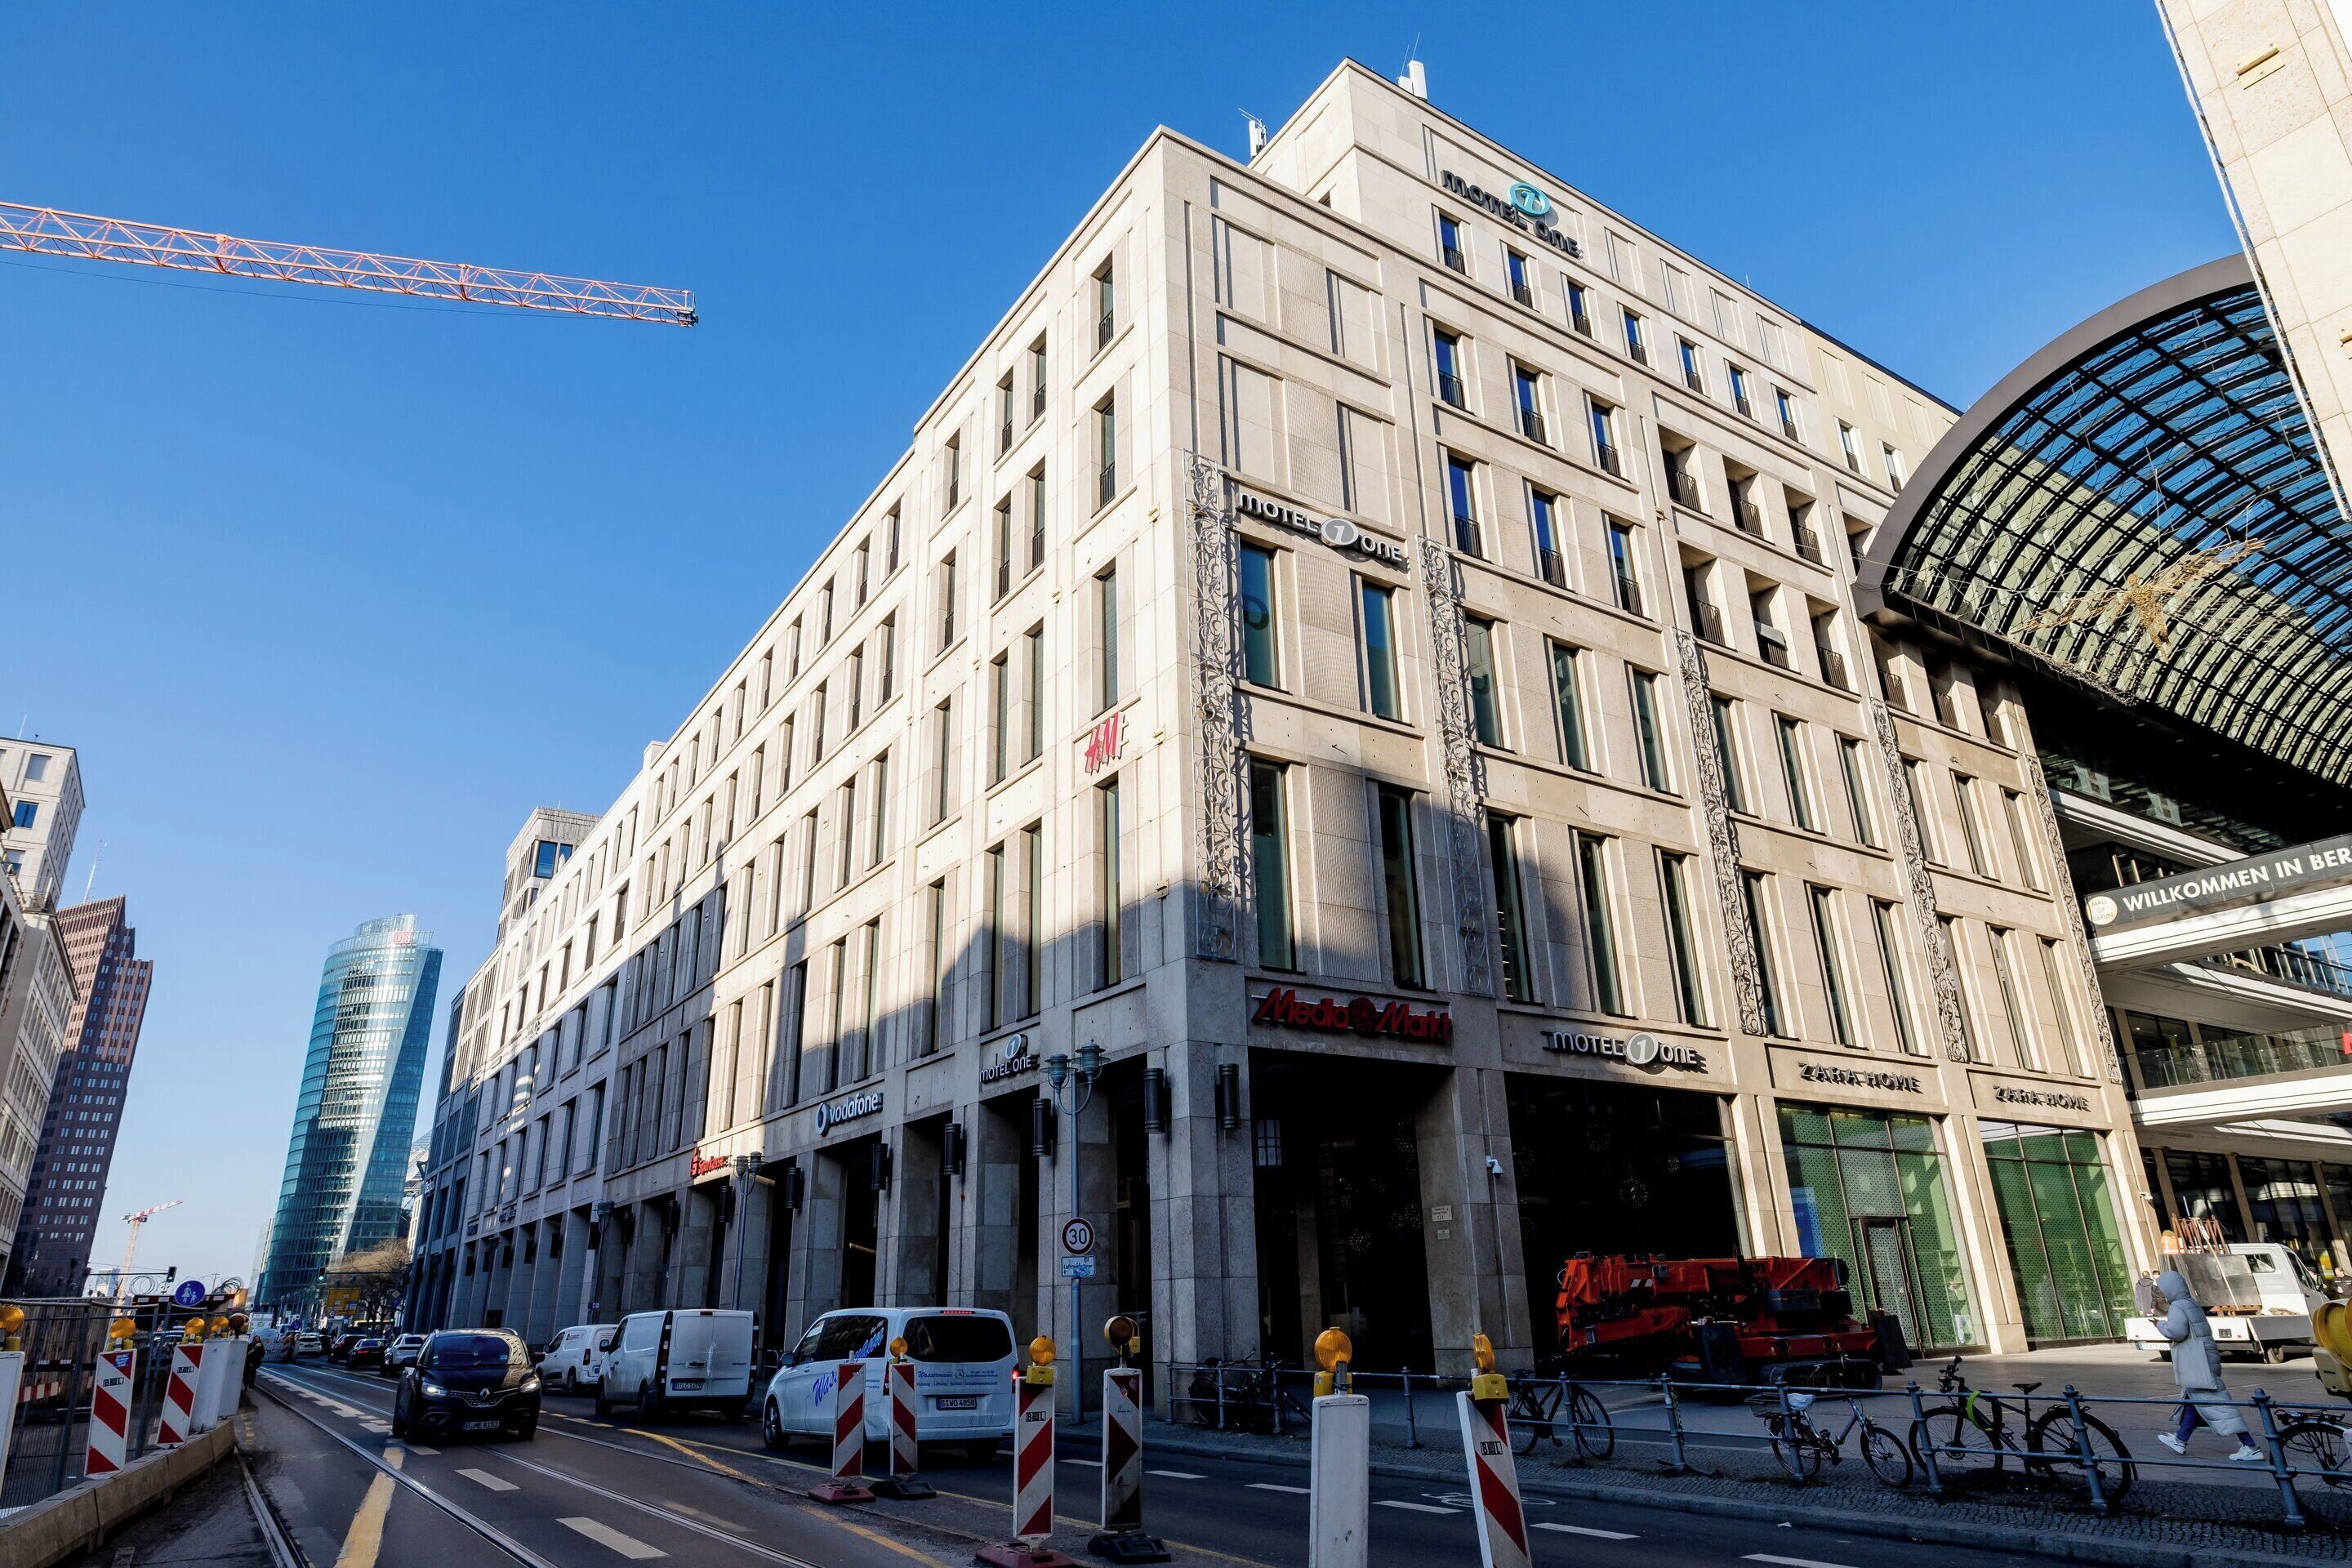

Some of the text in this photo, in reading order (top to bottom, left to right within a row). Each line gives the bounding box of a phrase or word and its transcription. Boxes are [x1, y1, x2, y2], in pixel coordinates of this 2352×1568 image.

[1441, 169, 1580, 259] MOTEL ONE
[1237, 492, 1319, 533] MOTEL
[1361, 534, 1403, 563] ONE
[2123, 846, 2352, 912] WILLKOMMEN IN BER
[1553, 1031, 1624, 1056] MOTEL
[1660, 1044, 1698, 1065] ONE
[980, 1054, 1031, 1083] MOTEL ONE
[1798, 1061, 1920, 1090] ZARA HOME
[830, 1093, 879, 1124] vodafone
[1993, 1085, 2090, 1110] ZARA HOME
[1068, 1228, 1088, 1245] 30
